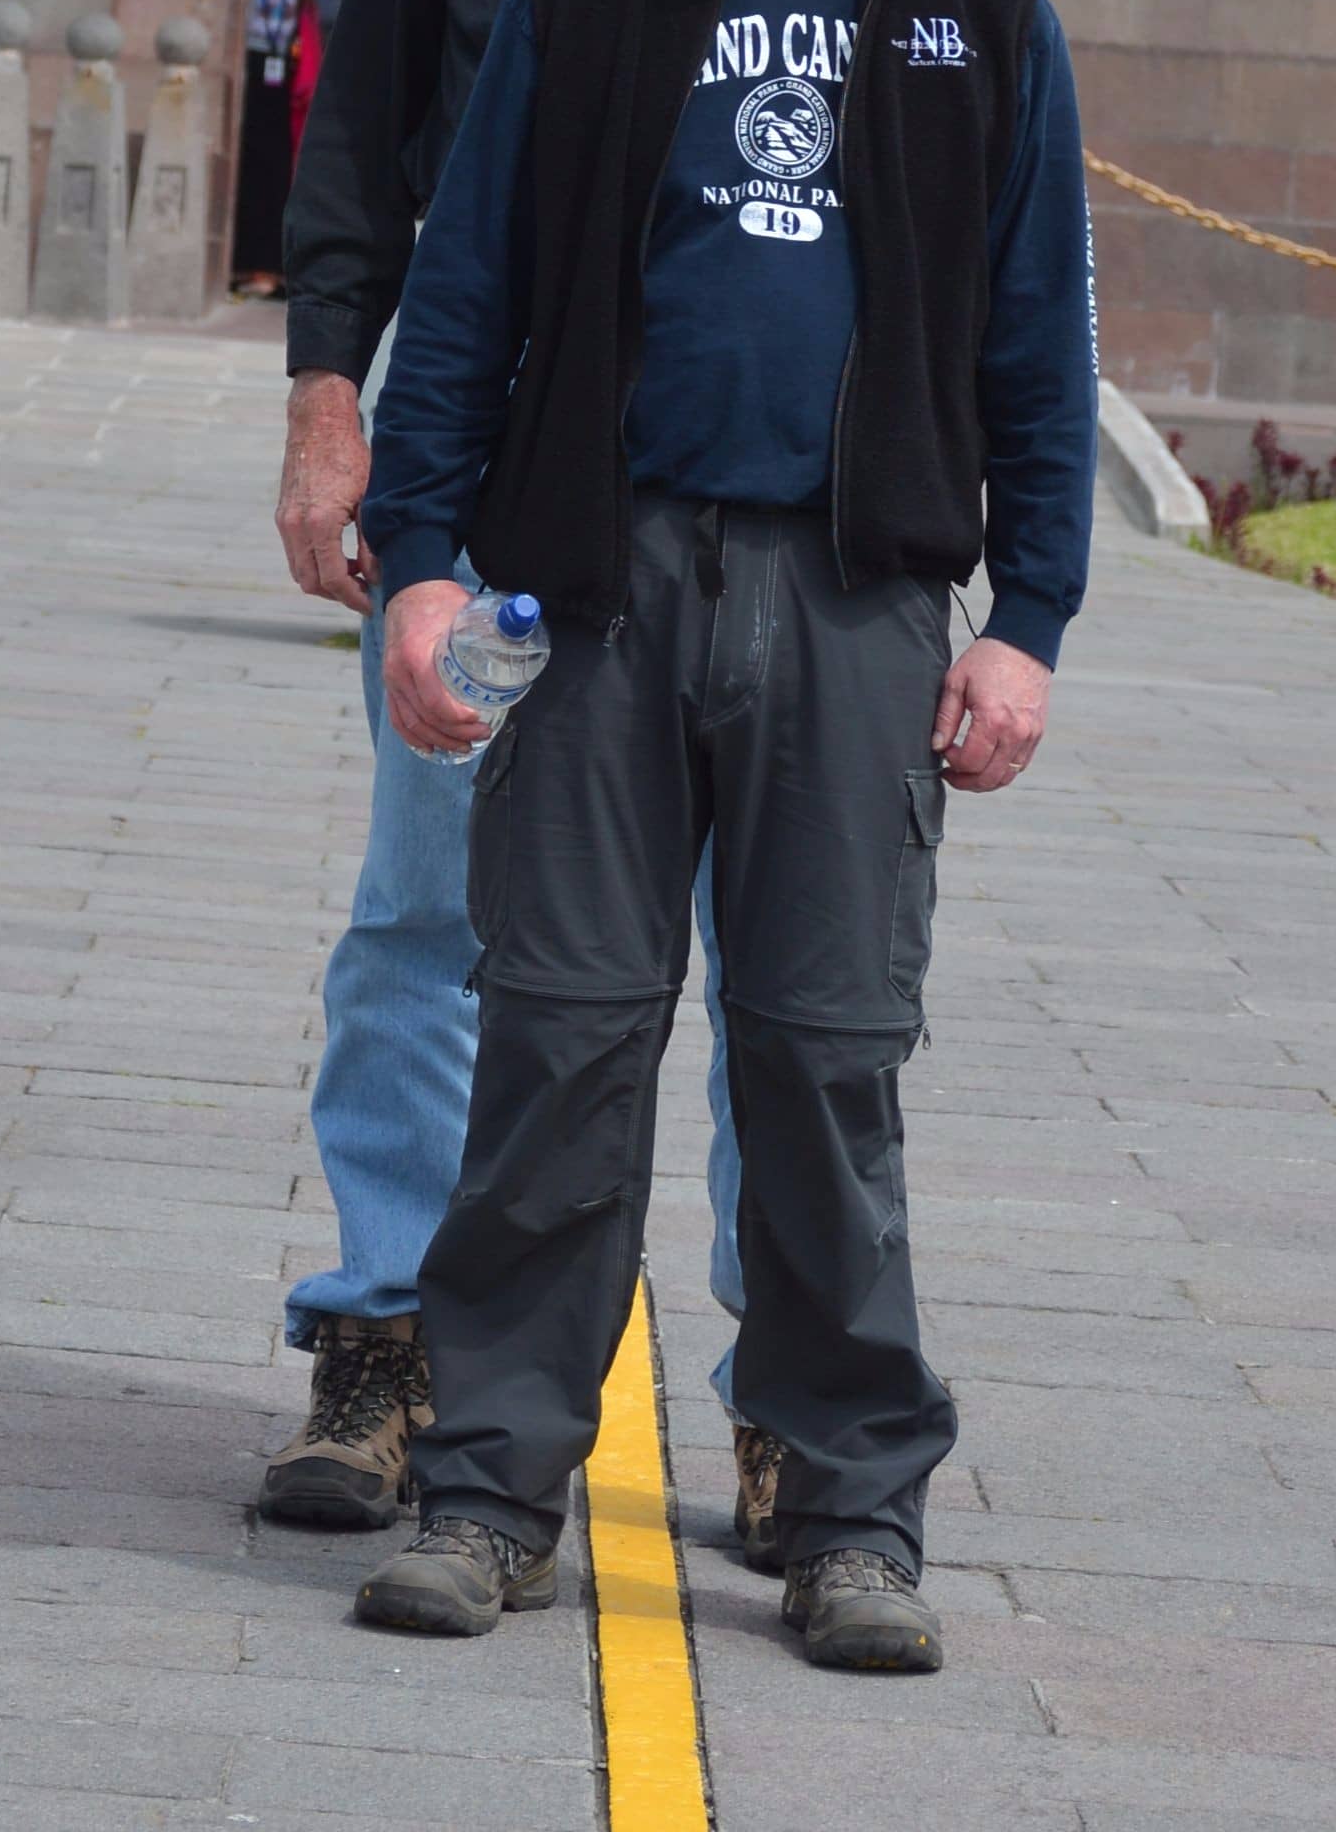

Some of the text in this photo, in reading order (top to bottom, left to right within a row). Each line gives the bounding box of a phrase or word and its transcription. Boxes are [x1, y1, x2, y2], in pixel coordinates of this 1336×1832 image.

[912, 17, 965, 59] NB
[702, 179, 845, 207] NATIONAL PA
[764, 207, 801, 236] 19
